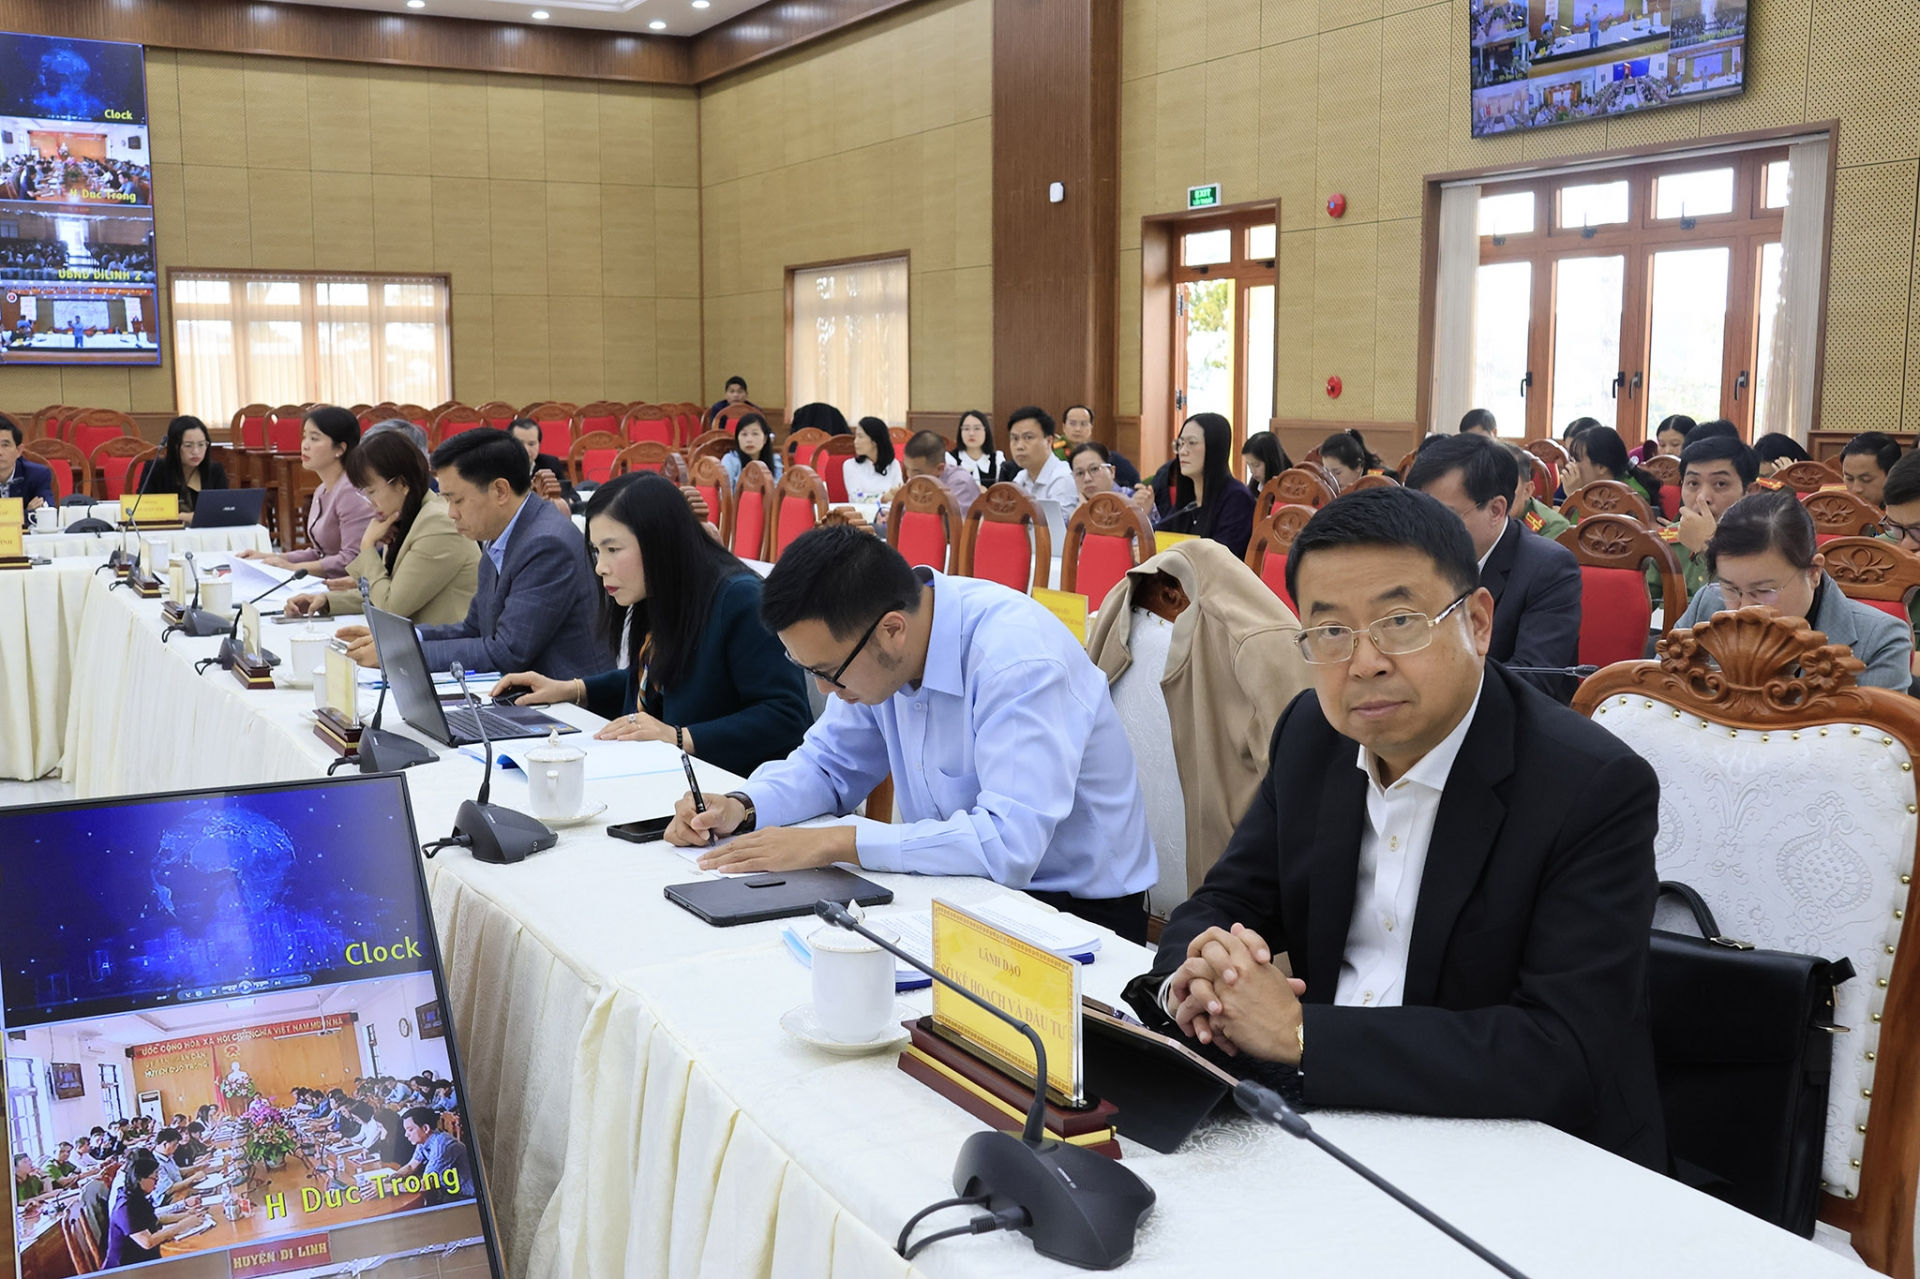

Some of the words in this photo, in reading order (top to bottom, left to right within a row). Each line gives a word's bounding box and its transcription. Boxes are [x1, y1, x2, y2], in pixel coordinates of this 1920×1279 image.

[104, 108, 133, 120] Clock
[82, 188, 102, 199] Duc
[106, 191, 136, 203] Trong
[58, 269, 90, 279] UBND
[134, 271, 142, 281] 2
[344, 935, 423, 966] Clock
[265, 1191, 288, 1220] H
[301, 1183, 362, 1214] Duc
[369, 1166, 461, 1200] Trong
[280, 1246, 293, 1261] DI
[297, 1242, 328, 1258] LINH
